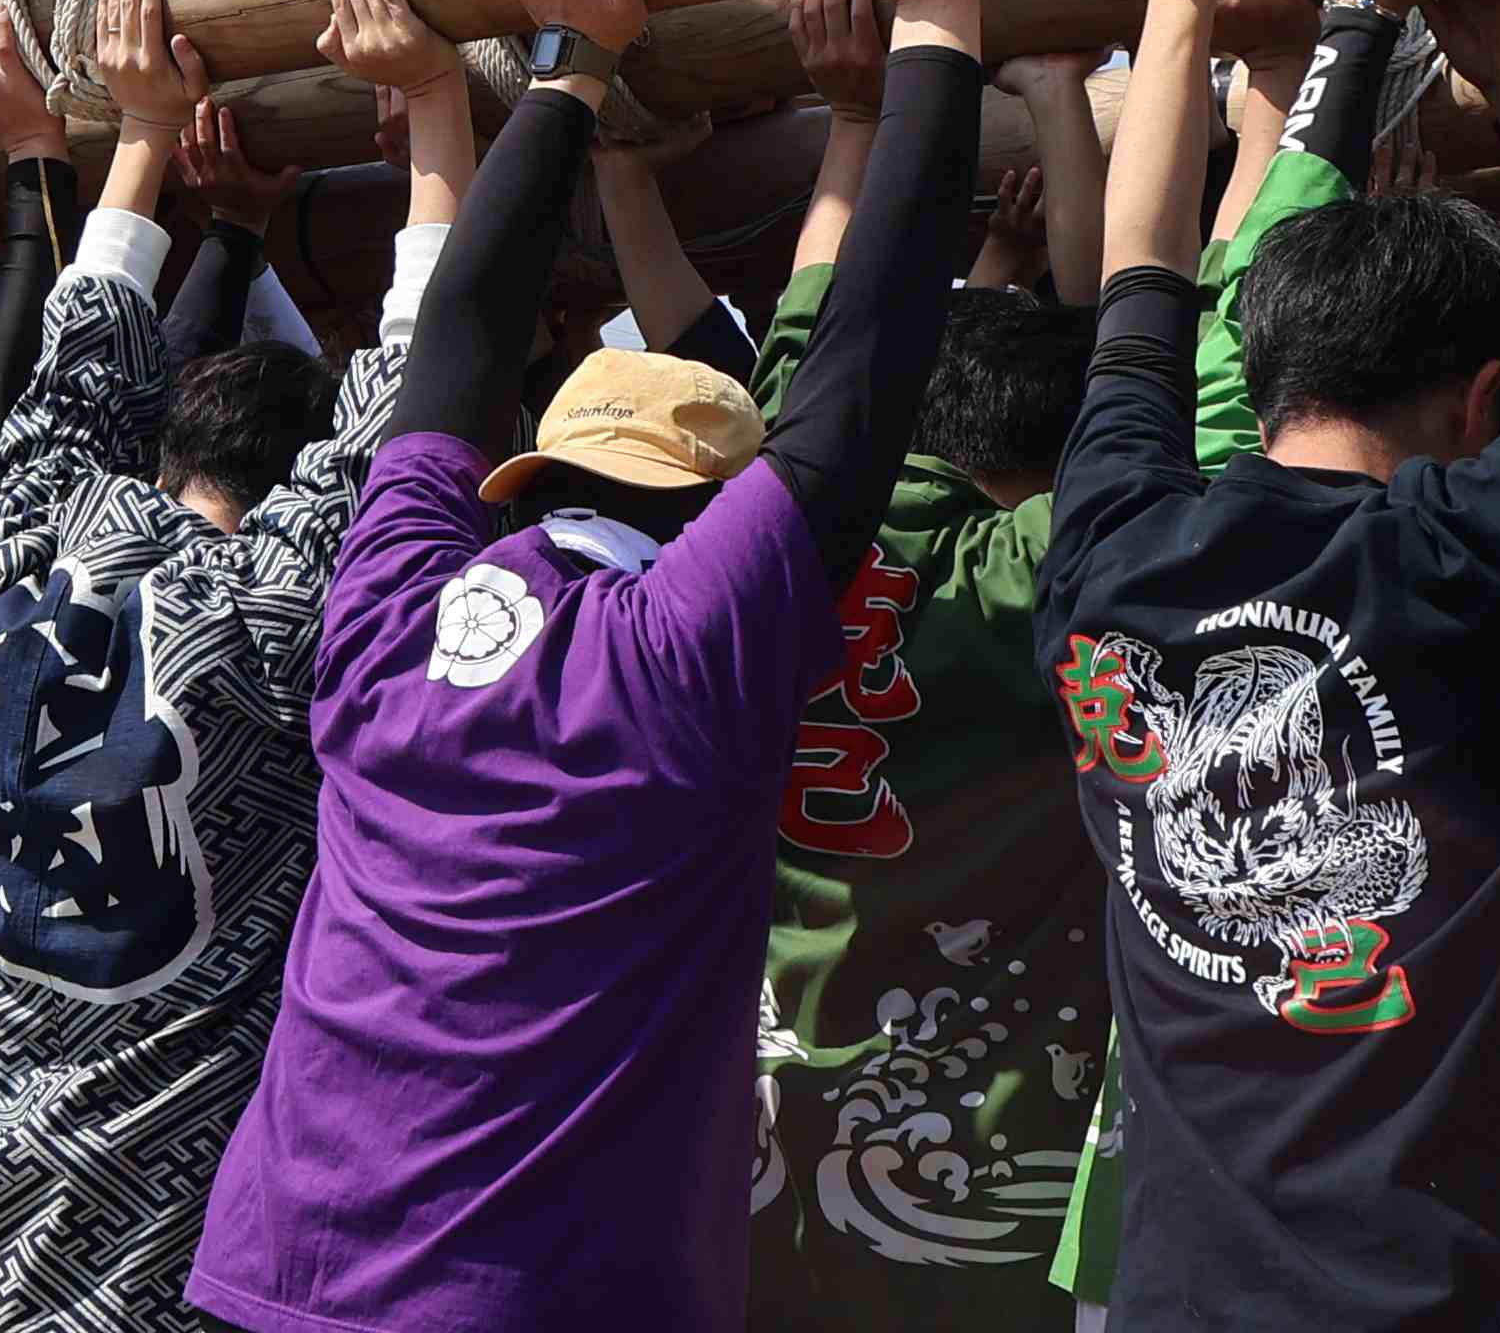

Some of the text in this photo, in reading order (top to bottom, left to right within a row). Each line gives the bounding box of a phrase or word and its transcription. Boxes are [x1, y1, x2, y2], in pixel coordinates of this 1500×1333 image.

[1195, 601, 1405, 775] HONMURA FAMILY
[1166, 933, 1247, 984] SPIRITS
